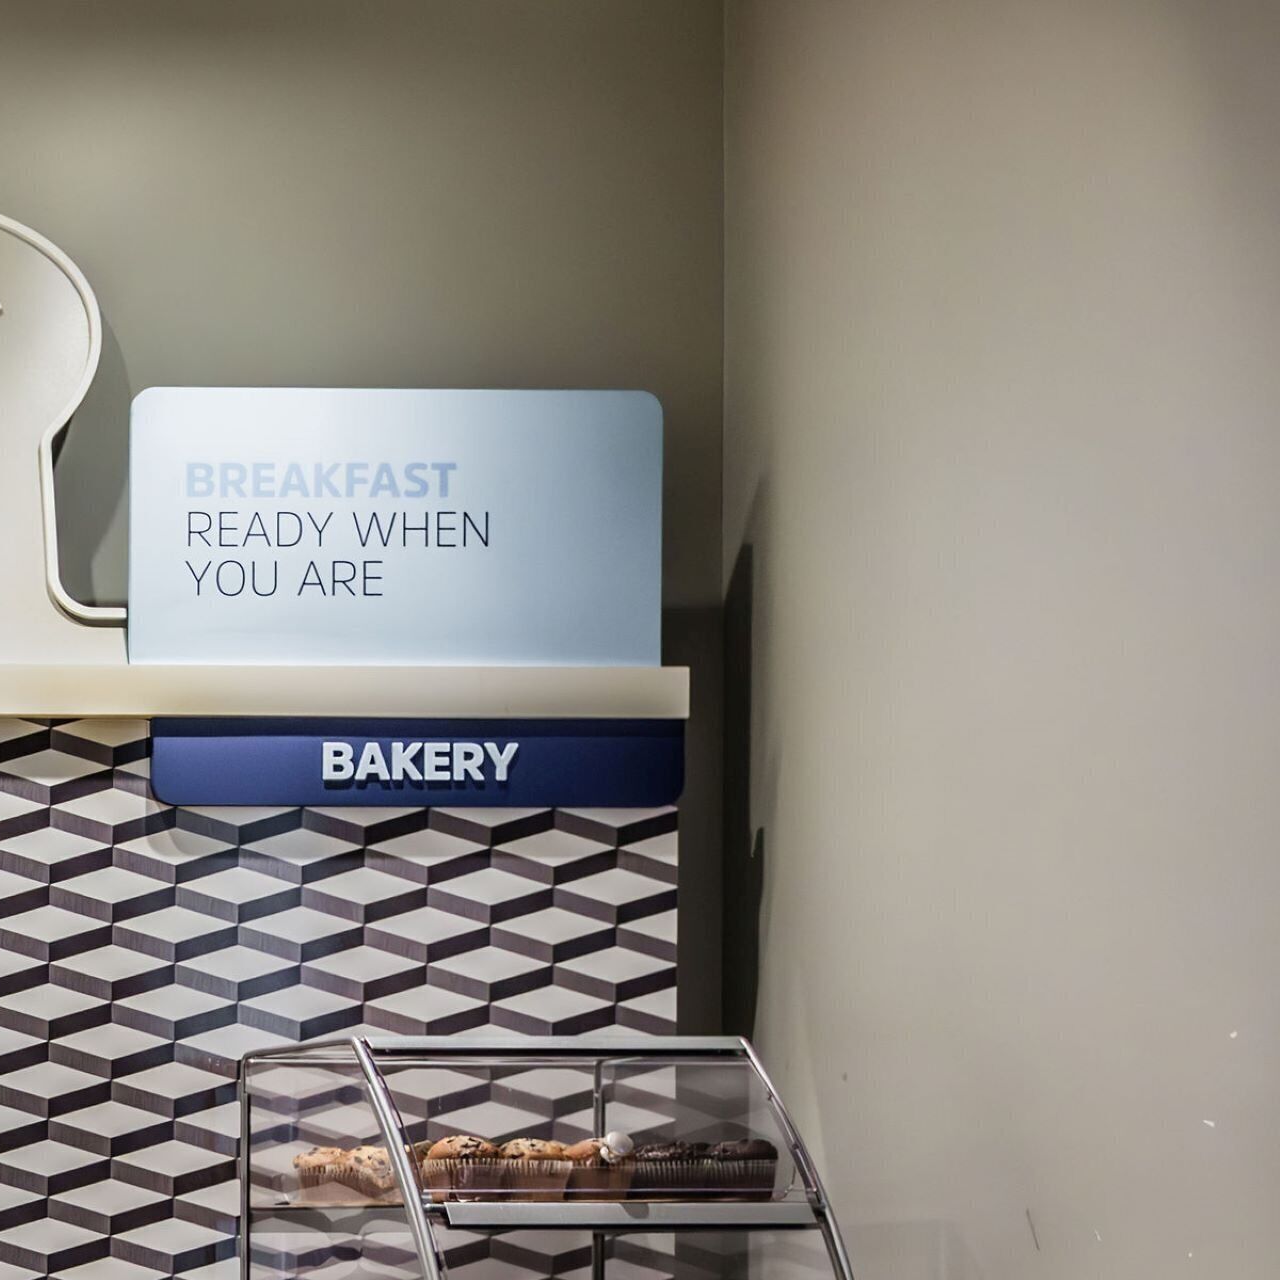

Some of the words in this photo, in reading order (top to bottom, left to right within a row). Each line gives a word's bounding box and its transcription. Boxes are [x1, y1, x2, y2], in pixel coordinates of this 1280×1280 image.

[185, 462, 458, 499] BREAKFAST
[186, 511, 332, 548] READY
[352, 511, 490, 548] WHEN
[185, 560, 279, 597] YOU
[297, 560, 384, 597] ARE
[322, 741, 520, 784] BAKERY
